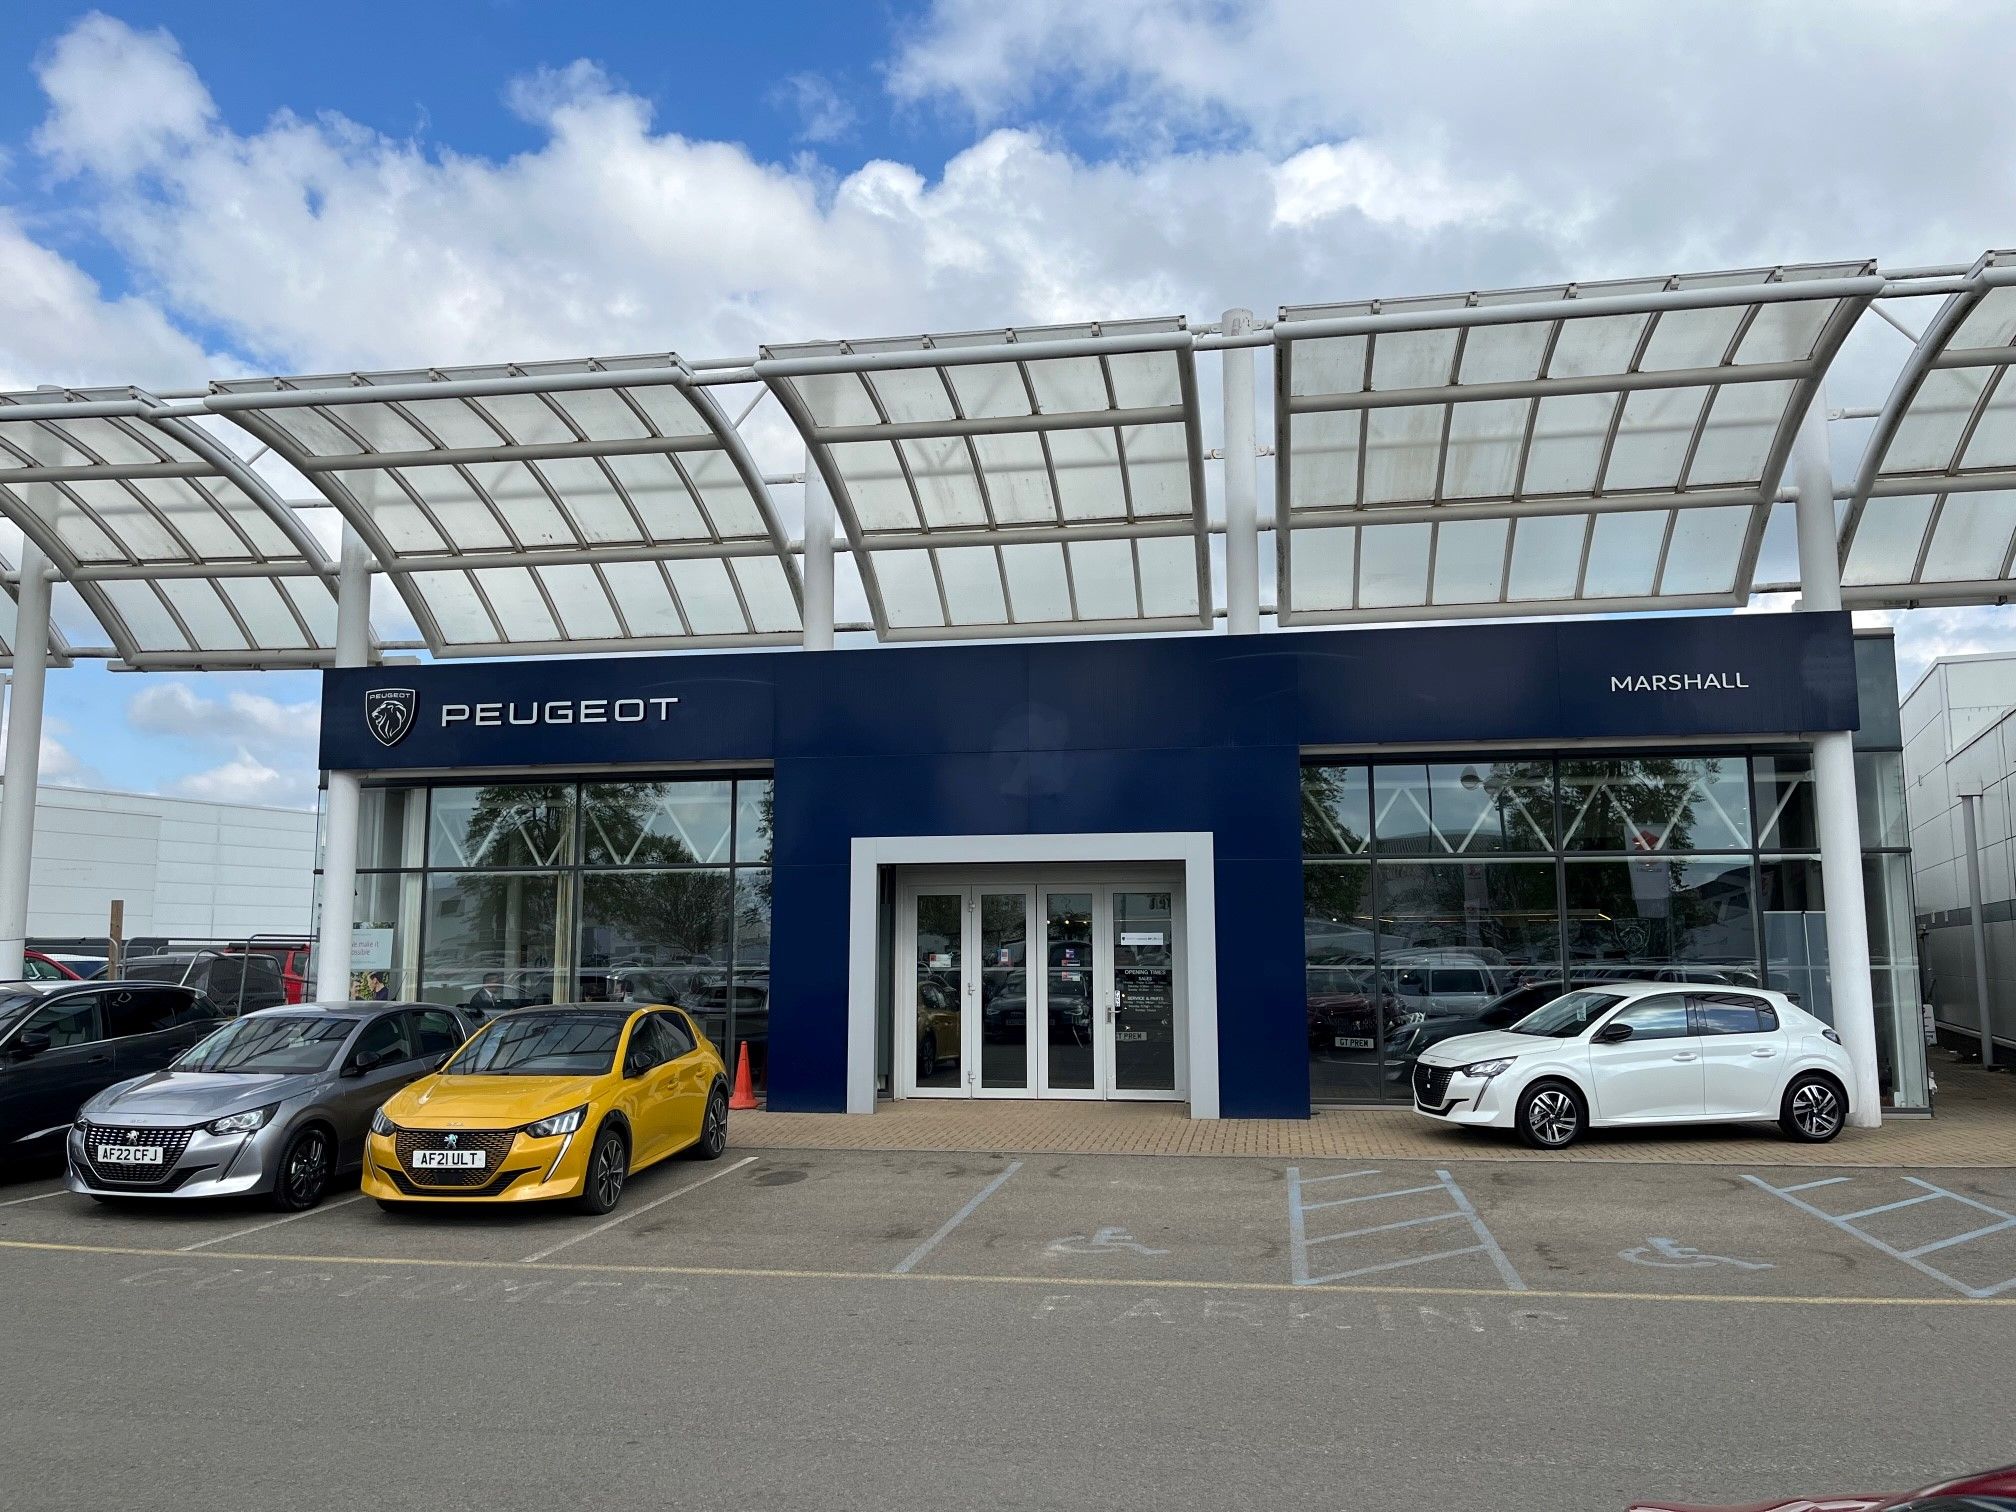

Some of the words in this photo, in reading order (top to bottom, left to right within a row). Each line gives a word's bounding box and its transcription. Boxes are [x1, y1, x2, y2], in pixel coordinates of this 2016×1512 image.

[1610, 672, 1749, 692] MARSHALL
[441, 697, 679, 727] PEUGEOT
[103, 1148, 131, 1160] AF22
[134, 1149, 157, 1161] CFJ
[421, 1153, 448, 1165] AF21
[452, 1153, 477, 1165] ULT
